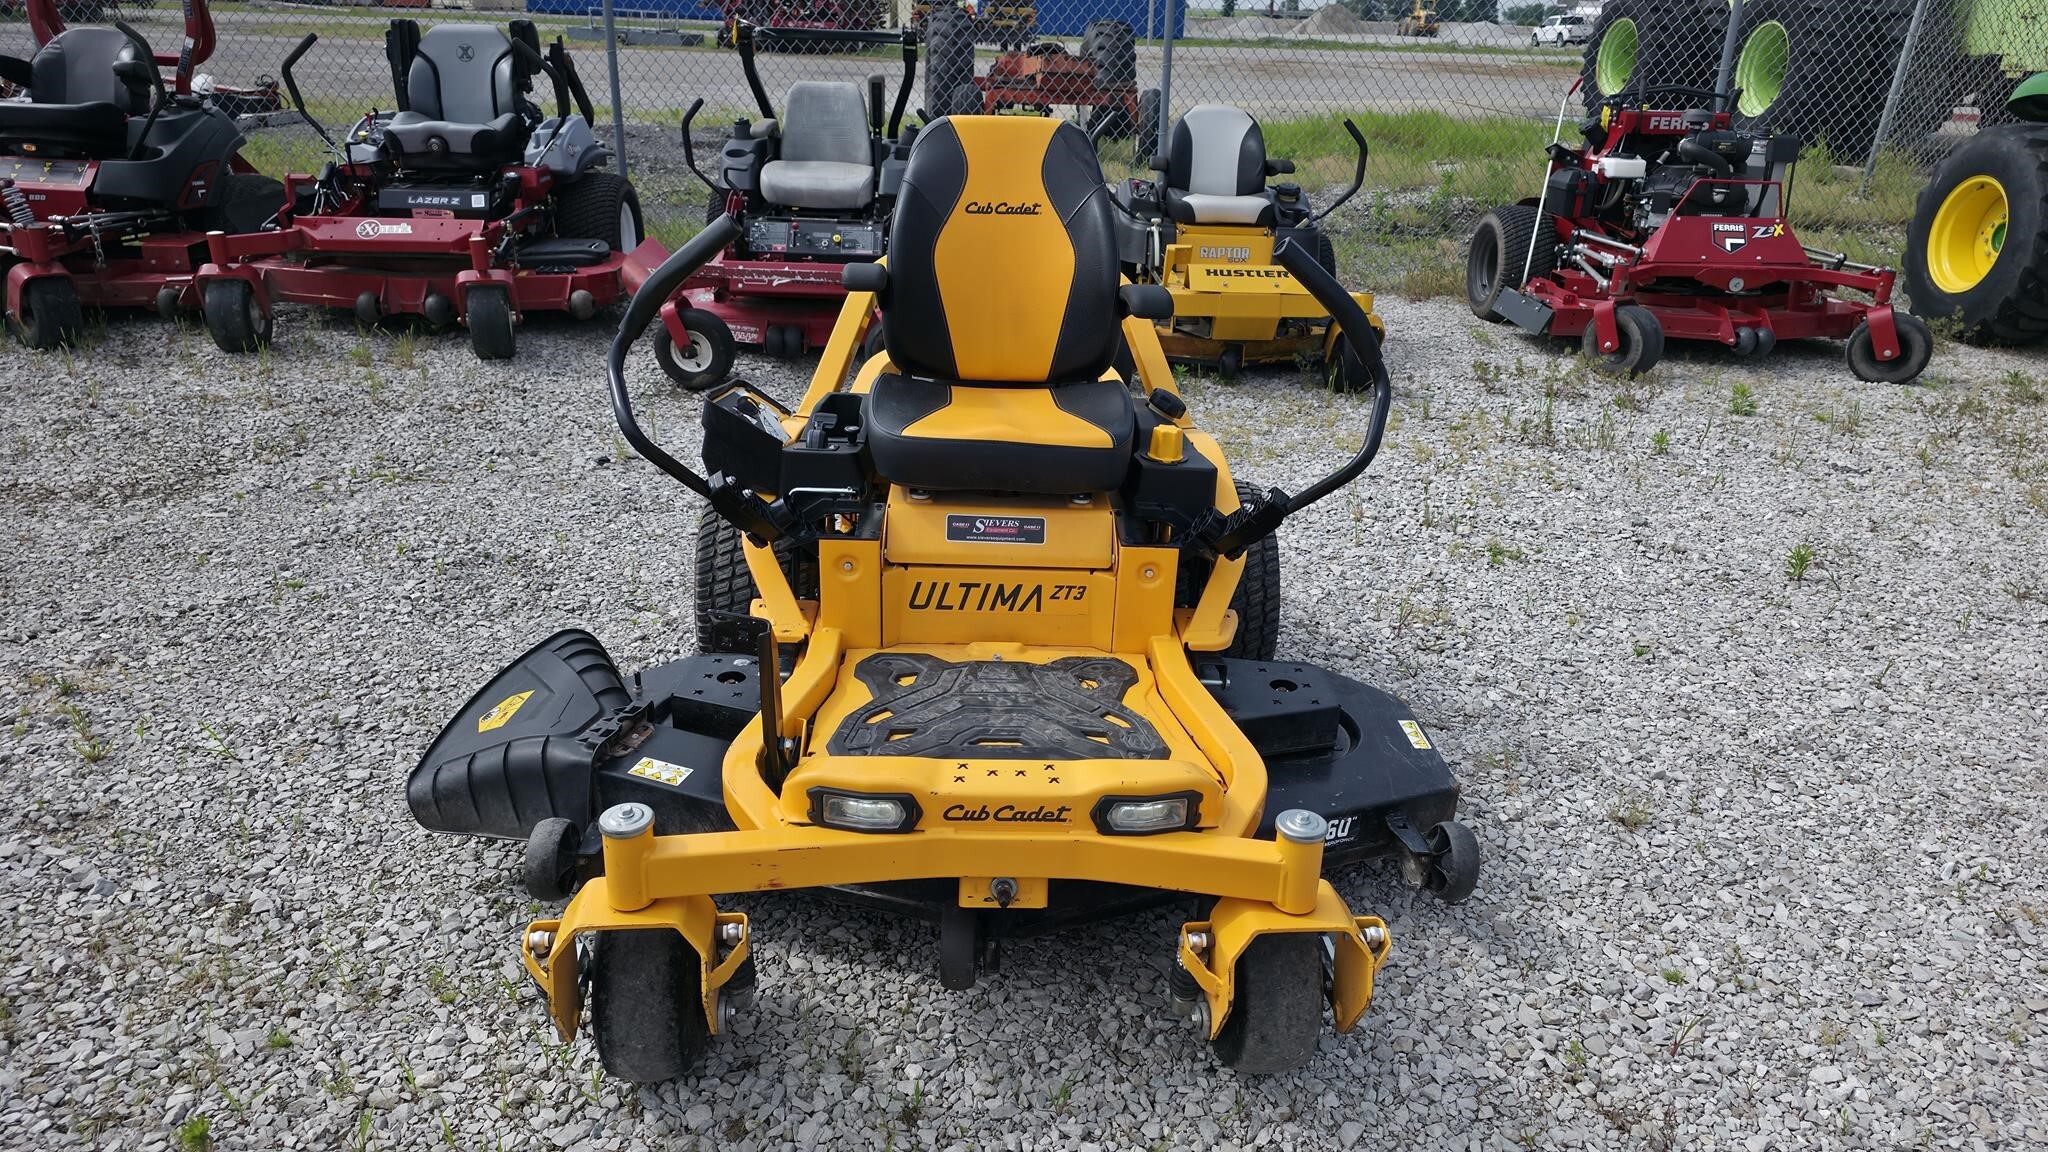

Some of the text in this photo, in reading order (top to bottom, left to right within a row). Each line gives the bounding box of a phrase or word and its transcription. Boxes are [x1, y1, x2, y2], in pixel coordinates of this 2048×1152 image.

[407, 196, 461, 205] LAZER Z
[964, 201, 1042, 216] Cub Cadet
[1713, 223, 1745, 232] FERRIS
[1200, 246, 1251, 260] RAPTOR
[1205, 268, 1290, 279] HUSTLER
[972, 518, 1021, 534] SIEVERS
[908, 581, 1088, 613] ULTIMA ZT3
[942, 804, 1072, 823] Cub Cadet
